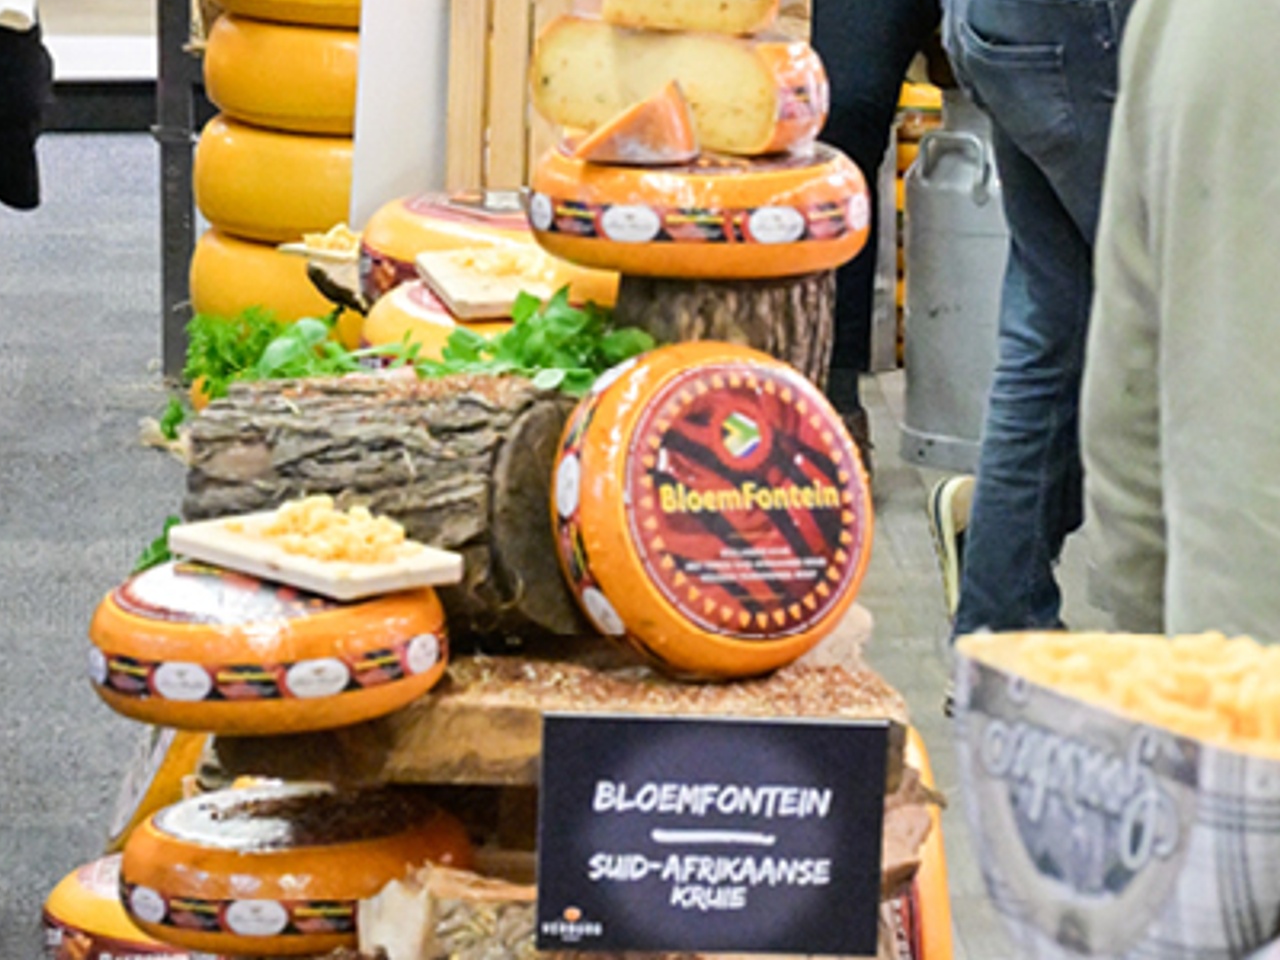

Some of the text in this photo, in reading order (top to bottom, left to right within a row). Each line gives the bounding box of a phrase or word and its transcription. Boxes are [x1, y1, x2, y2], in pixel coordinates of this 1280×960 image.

[659, 479, 840, 513] BloemFontein
[592, 780, 833, 818] BLOEMFONTEIN
[587, 852, 833, 887] SUID-AFRIKAANSE
[669, 886, 748, 910] KRUIE
